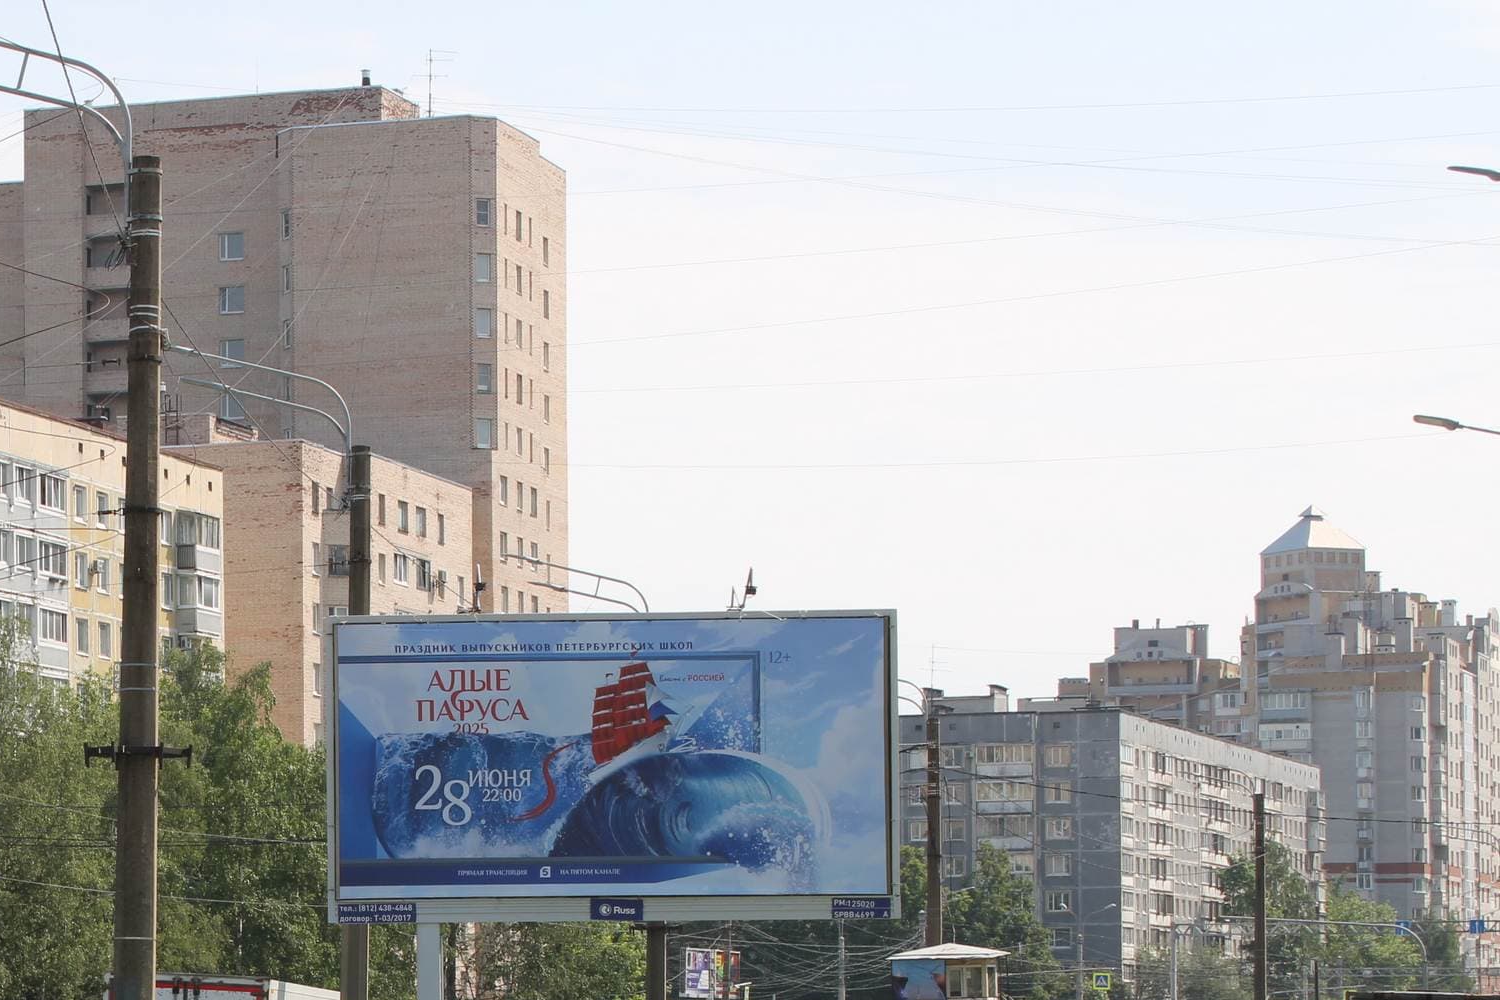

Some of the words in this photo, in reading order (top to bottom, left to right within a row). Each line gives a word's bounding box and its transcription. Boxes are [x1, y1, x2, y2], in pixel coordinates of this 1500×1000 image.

[394, 643, 456, 655] ПРАЗДНИК
[461, 642, 550, 653] ВЫПУСКНИКОВ
[556, 641, 655, 652] ПЕТЕРБУРГСКИХ
[659, 640, 693, 650] ШКОЛ
[768, 651, 792, 664] 12+
[427, 668, 512, 692] АЛЫЕ
[687, 672, 725, 682] РОССИЕЙ
[415, 697, 530, 722] ПАРУСА
[453, 722, 490, 735] 2025
[414, 764, 472, 826] 28
[468, 768, 532, 788] ИЮНЯ
[482, 788, 522, 802] 22:00
[358, 904, 377, 912] (812)
[613, 906, 636, 915] Russ
[340, 915, 373, 923] договор:
